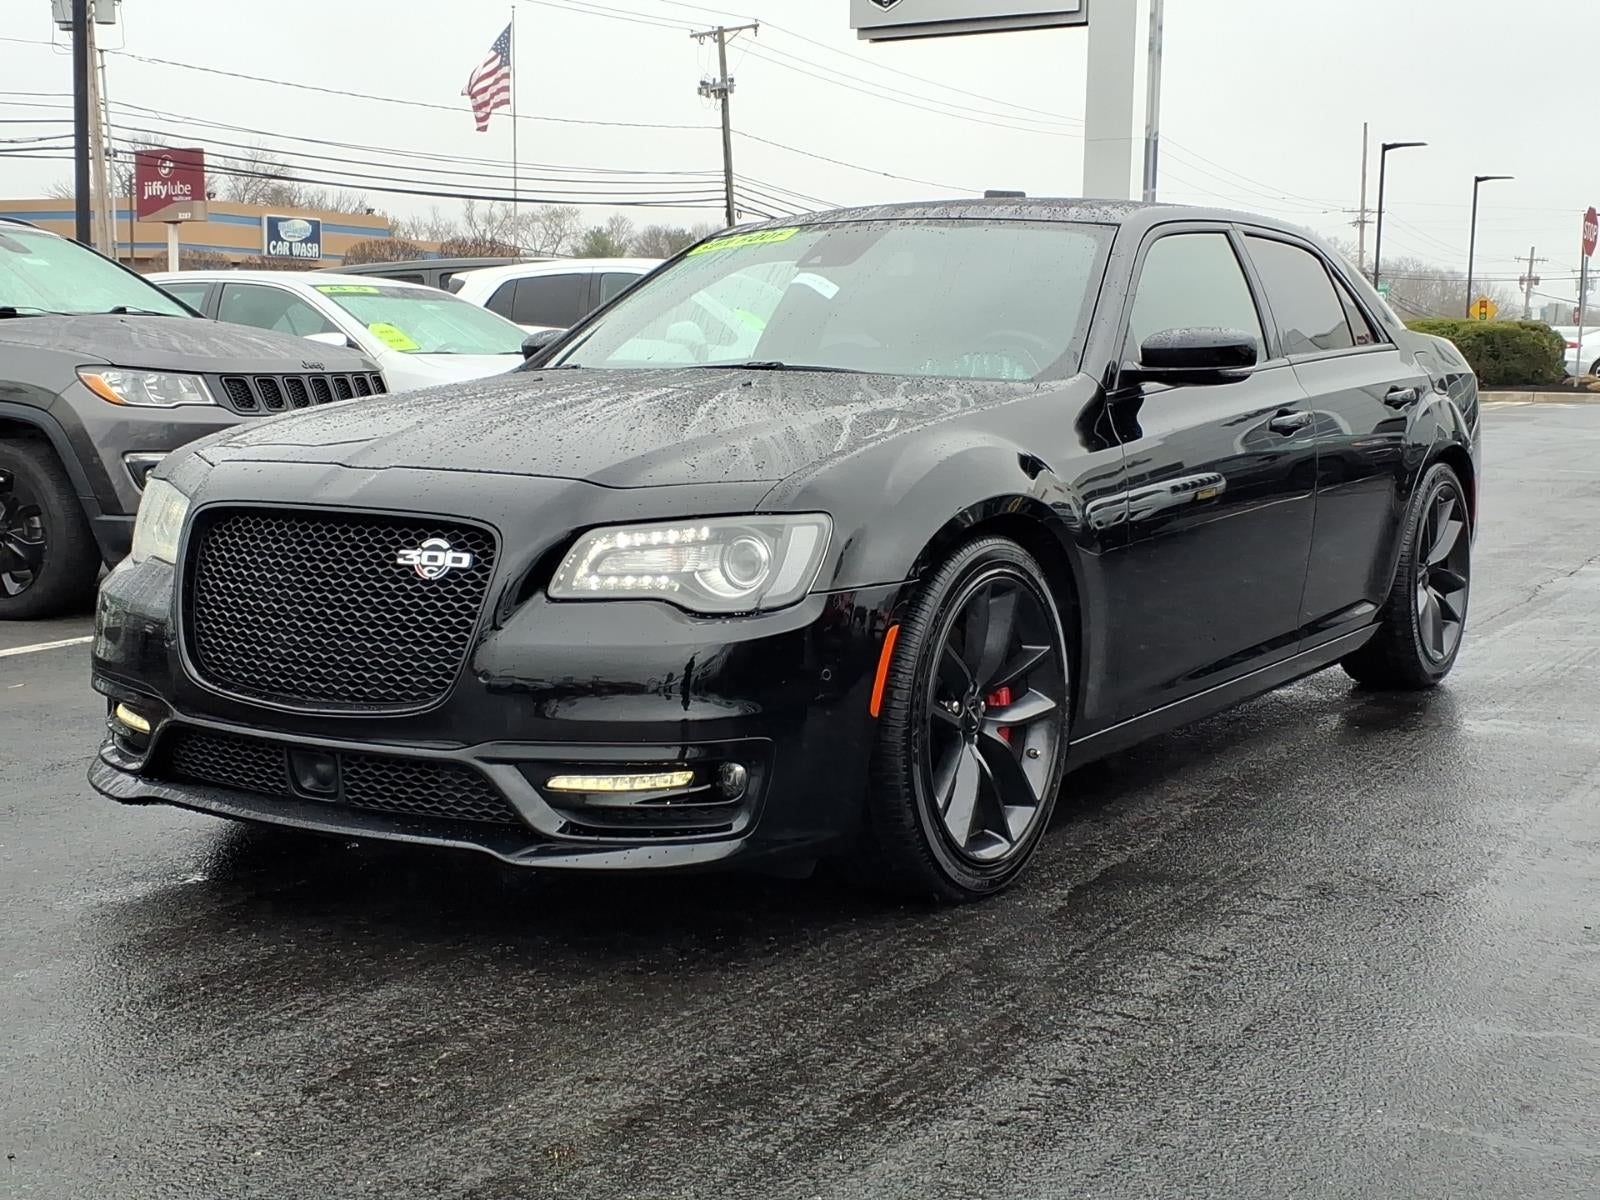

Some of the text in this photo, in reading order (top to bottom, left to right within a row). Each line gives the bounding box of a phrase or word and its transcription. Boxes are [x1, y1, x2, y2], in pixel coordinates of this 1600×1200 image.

[143, 181, 192, 200] jiffy lube
[1584, 221, 1598, 242] STOP
[269, 240, 319, 258] CAR WASH
[397, 548, 471, 568] 300
